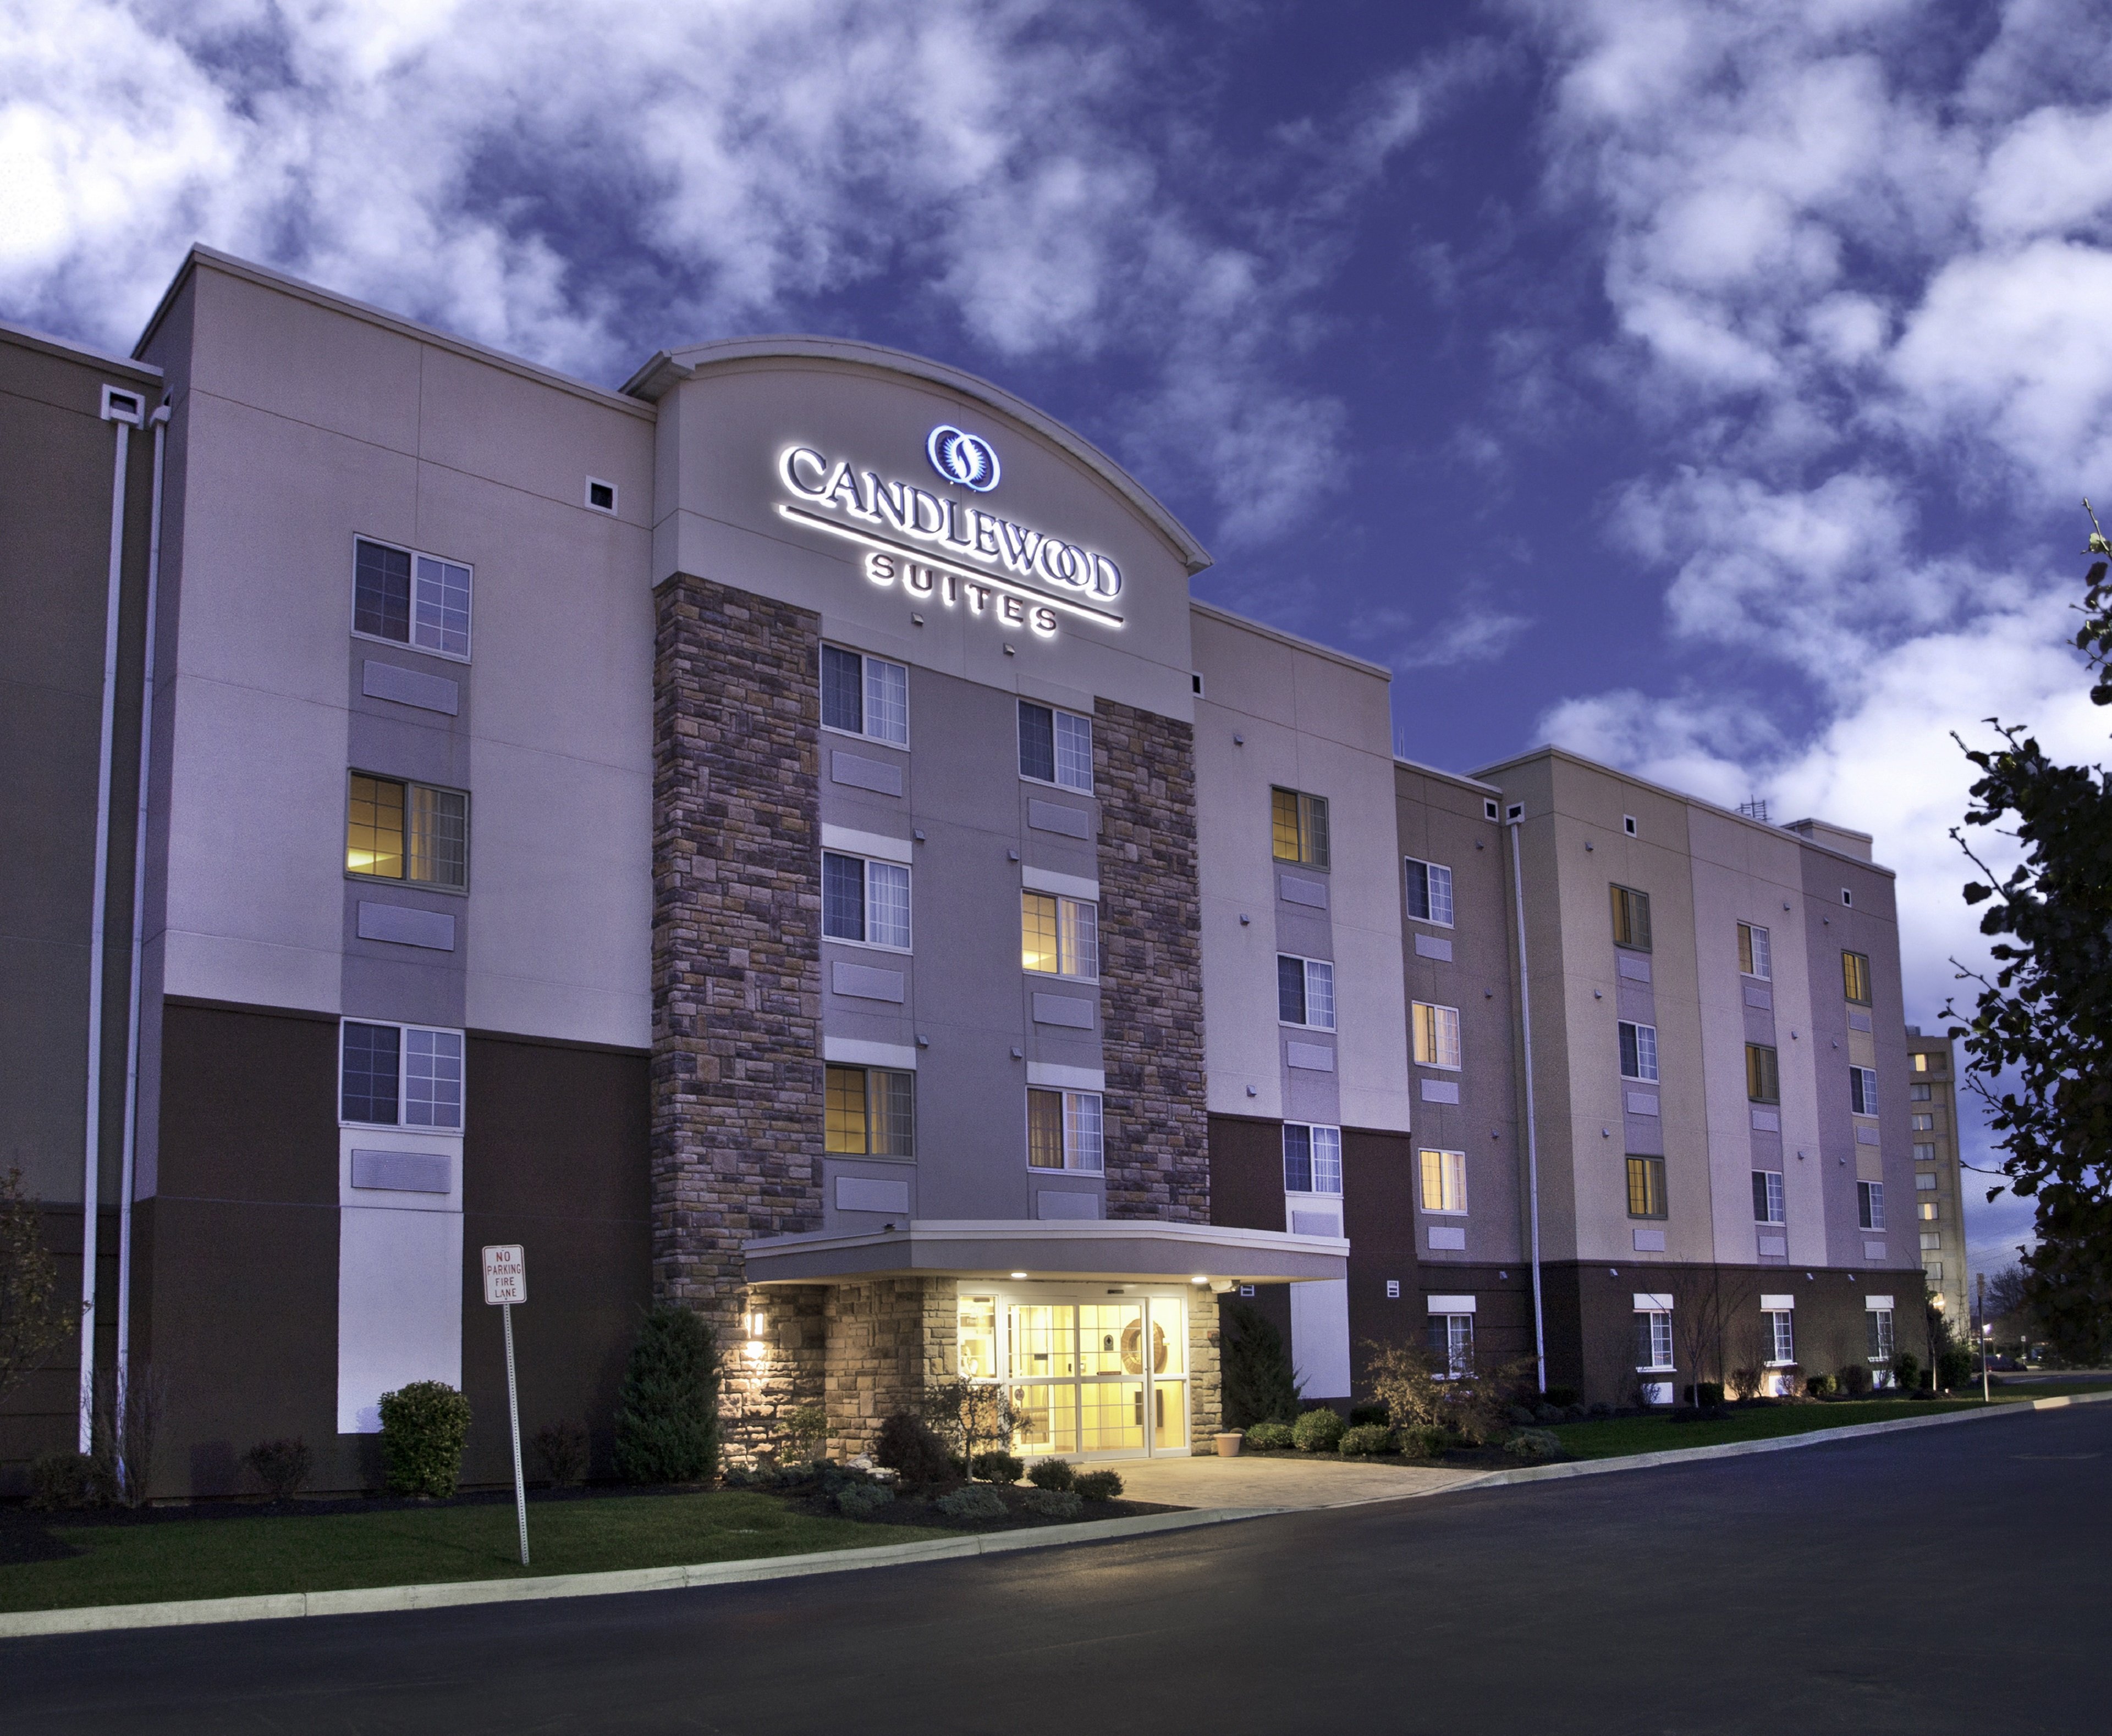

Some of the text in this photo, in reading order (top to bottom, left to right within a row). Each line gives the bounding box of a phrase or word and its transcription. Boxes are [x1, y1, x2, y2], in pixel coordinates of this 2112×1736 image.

[778, 446, 1122, 601] CANDLEWOOD
[865, 552, 1057, 637] SUITES
[496, 1251, 510, 1262] NO
[487, 1264, 521, 1275] PARKING
[495, 1277, 515, 1286] FIRE
[495, 1288, 516, 1298] LANE
